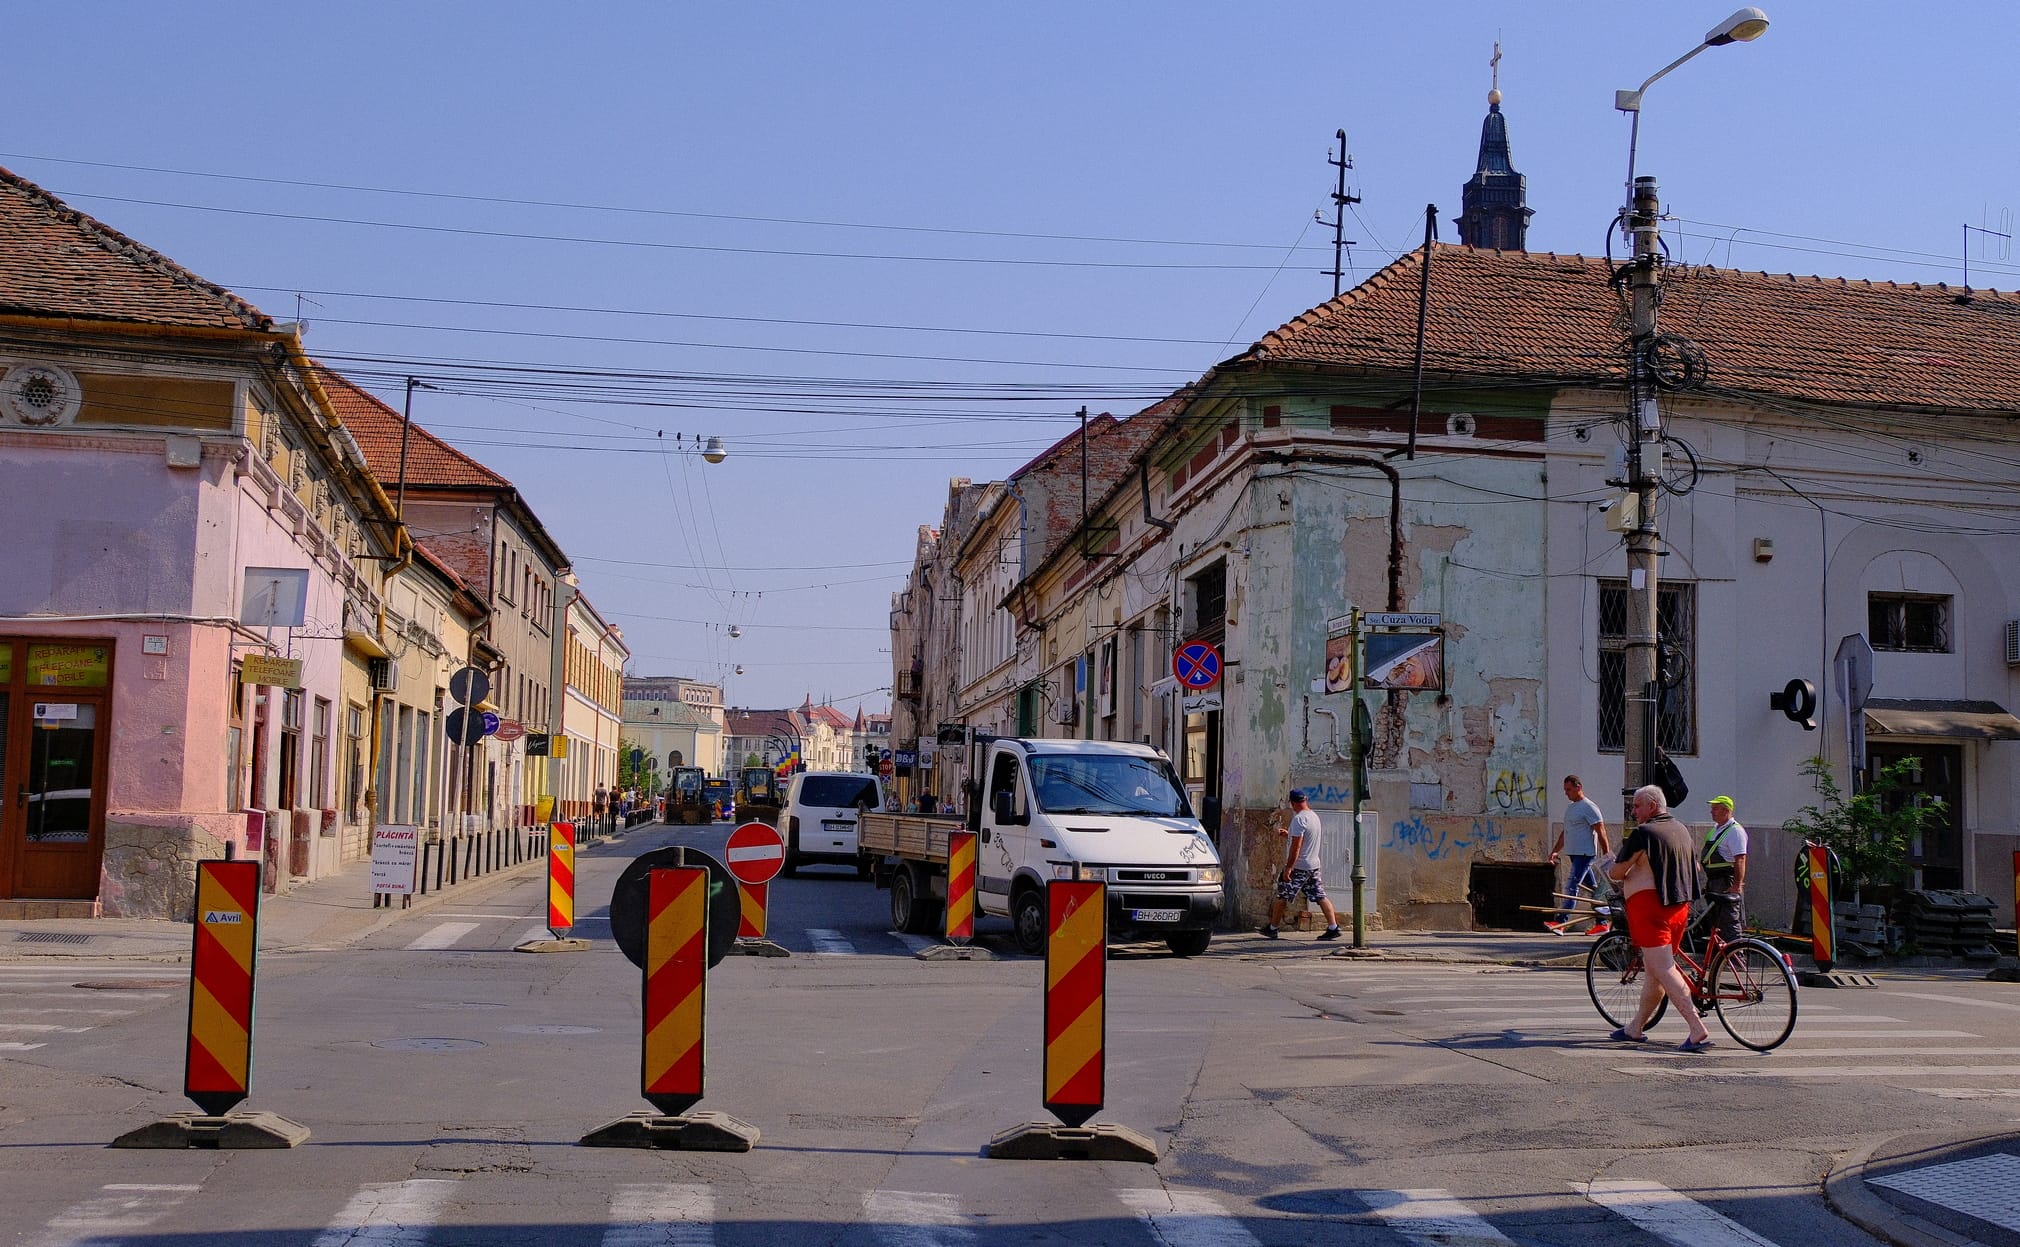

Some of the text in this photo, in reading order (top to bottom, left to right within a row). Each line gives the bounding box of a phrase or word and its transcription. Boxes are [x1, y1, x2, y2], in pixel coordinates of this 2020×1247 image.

[1381, 615, 1406, 624] Cuza
[1409, 615, 1433, 624] Vodă
[32, 658, 94, 673] TELEFOANE
[248, 665, 297, 677] TELEFOANE
[258, 675, 289, 685] MOBILE
[880, 763, 892, 771] STOP
[1143, 872, 1166, 880] IVECO
[220, 913, 242, 922] Avril
[1137, 911, 1151, 920] BH
